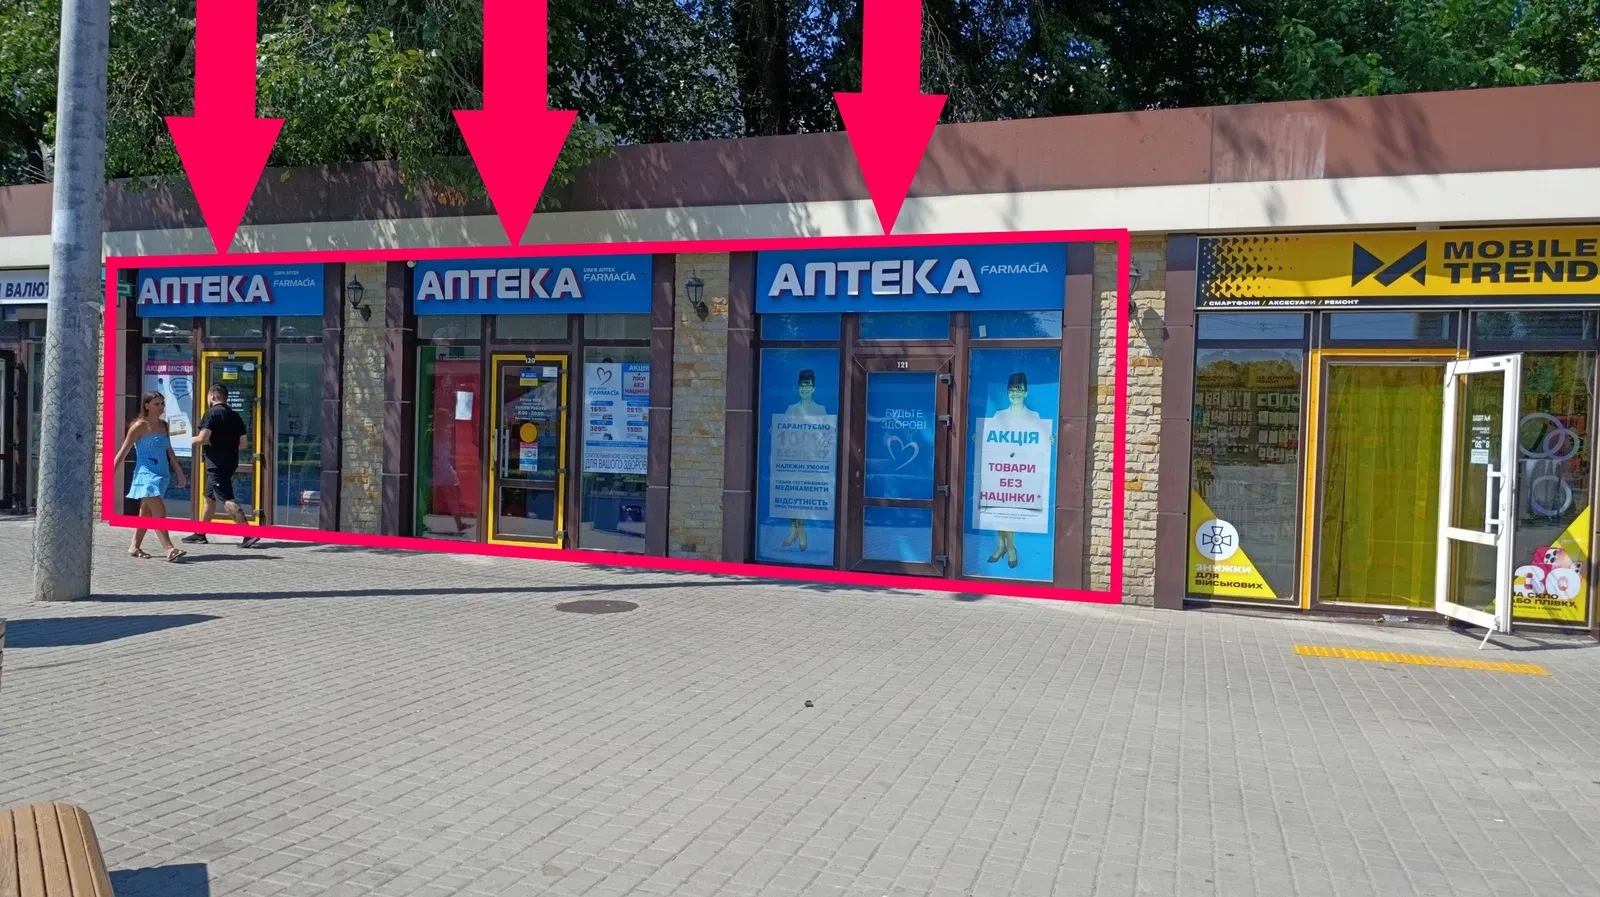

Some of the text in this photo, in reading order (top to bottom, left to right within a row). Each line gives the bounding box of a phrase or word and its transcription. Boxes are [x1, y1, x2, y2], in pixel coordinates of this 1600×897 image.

[1443, 238, 1598, 259] MOBILE
[768, 258, 981, 296] АПТЕКА
[1443, 261, 1598, 284] TREND
[137, 274, 271, 304] АПТЕКА
[416, 267, 582, 300] АПТЕКА
[897, 361, 908, 369] 121
[885, 408, 924, 420] БУДЬТЕ
[777, 422, 831, 431] ГАРАНТУЄМО
[881, 420, 927, 431] ЗДОРОВІ
[986, 430, 1040, 446] АКЦІЯ
[988, 463, 1036, 474] ТОВАРИ
[775, 484, 829, 492] МЕДИКАМЕНТИ
[999, 478, 1023, 488] БЕЗ
[774, 497, 828, 506] ВІДСУТНІСТЬ
[1195, 563, 1252, 574] ЗНИЖКИ
[1195, 572, 1219, 580] ДЛЯ
[1195, 580, 1263, 589] ВІЙСЬКОВИХ
